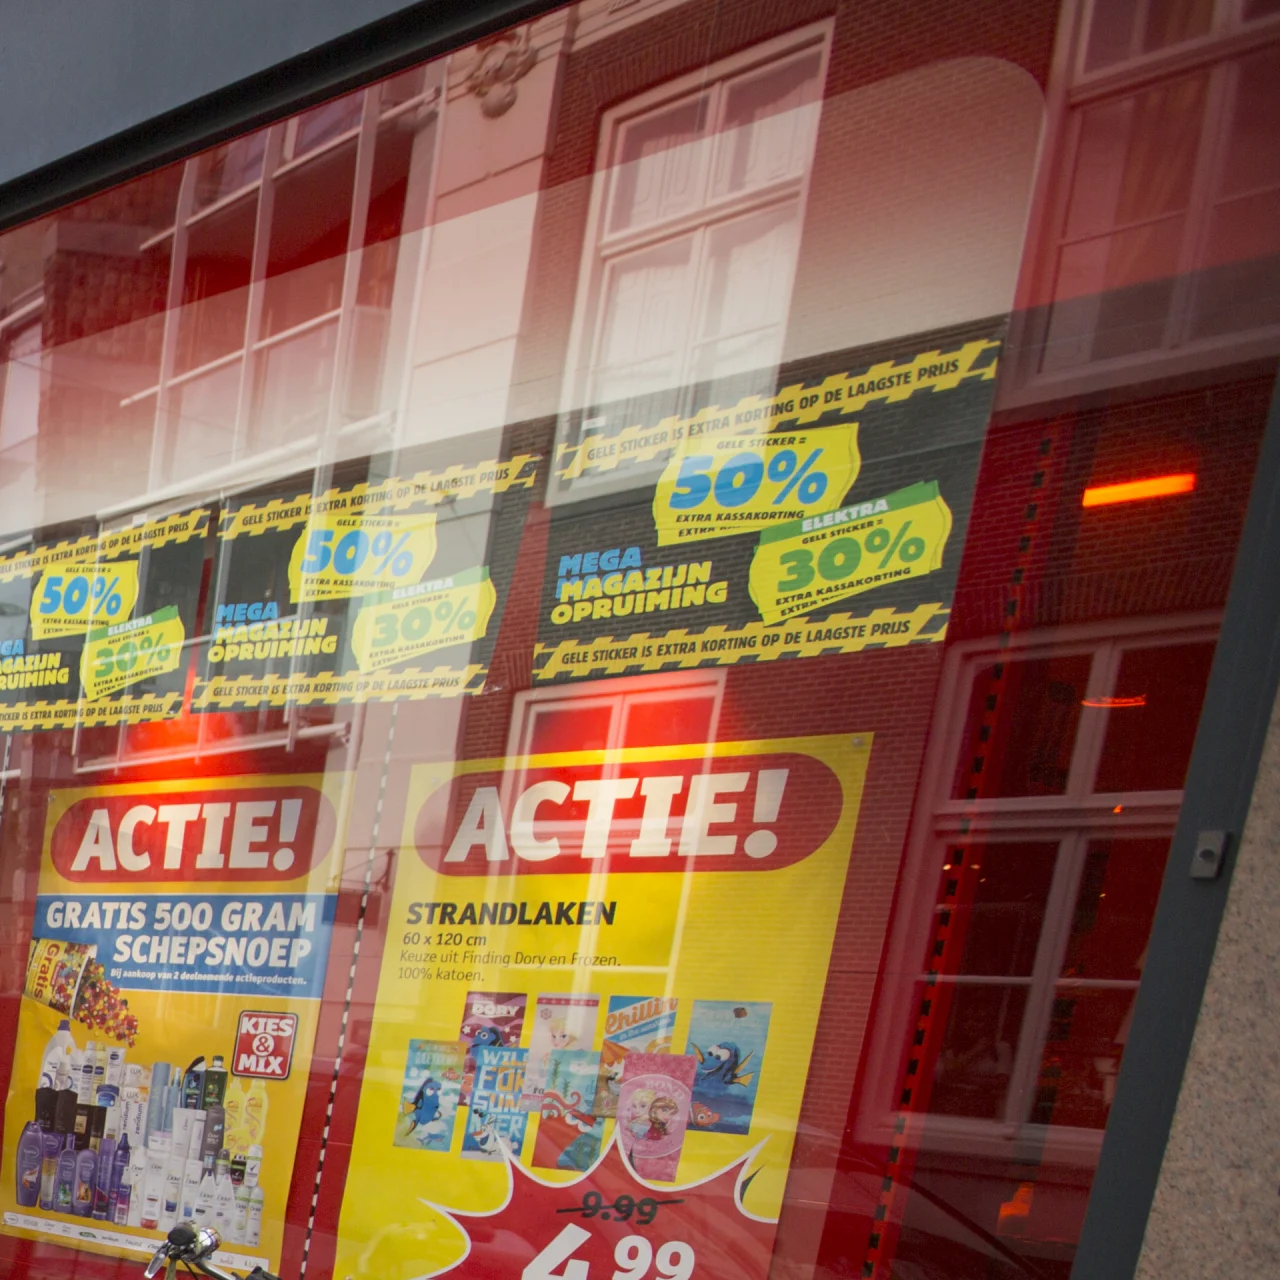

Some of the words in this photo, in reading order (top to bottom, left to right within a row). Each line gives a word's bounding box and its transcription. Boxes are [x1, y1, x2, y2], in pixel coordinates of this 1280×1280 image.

[587, 443, 616, 461] GELE
[620, 428, 667, 455] STICKER
[673, 424, 684, 439] IS
[688, 415, 730, 439] EXTRA
[734, 399, 795, 428] KORTING
[799, 391, 820, 410] OP
[825, 386, 842, 403] DE
[847, 371, 912, 398] LAAGSTE
[917, 359, 960, 380] PRIJS
[717, 440, 744, 449] GELE
[749, 437, 796, 448] STICKER
[669, 448, 828, 510] 50%
[242, 513, 263, 526] GELE
[267, 507, 301, 523] STICKER
[305, 504, 313, 515] IS
[316, 498, 347, 513] EXTRA
[351, 490, 393, 508] KORTING
[396, 487, 410, 499] OP
[413, 482, 427, 496] DE
[430, 474, 475, 493] LAAGSTE
[479, 468, 510, 482] PRIJS
[676, 514, 712, 522] EXTRA
[716, 511, 805, 521] KASSAKORTING
[802, 499, 888, 532] ELEKTRA
[15, 557, 40, 571] STICKER
[42, 556, 48, 564] IS
[51, 550, 73, 562] EXTRA
[76, 542, 106, 556] KORTING
[109, 538, 119, 549] OP
[121, 535, 131, 546] DE
[133, 527, 165, 542] LAAGSTE
[168, 521, 189, 536] PRIJS
[802, 533, 827, 544] GELE
[830, 521, 874, 538] STICKER
[300, 530, 413, 577] 50%
[559, 547, 642, 576] MEGA
[778, 521, 925, 592] 30%
[39, 575, 122, 616] 50%
[305, 578, 330, 586] EXTRA
[393, 578, 454, 599] ELEKTRA
[560, 561, 712, 602] MAGAZIJN
[776, 591, 812, 606] EXTRA
[816, 567, 911, 596] KASSAKORTING
[217, 601, 278, 622] MEGA
[551, 581, 727, 625] OPRUIMING
[108, 616, 152, 636] ELEKTRA
[215, 618, 328, 644] MAGAZIJN
[372, 596, 476, 647] 30%
[95, 632, 170, 678] 30%
[207, 635, 337, 663] OPRUIMING
[561, 651, 589, 664] GELE
[592, 646, 637, 663] STICKER
[642, 645, 653, 657] IS
[657, 640, 697, 656] EXTRA
[701, 635, 758, 652] KORTING
[761, 632, 780, 648] OP
[784, 630, 801, 644] DE
[807, 625, 866, 642] LAAGSTE
[870, 619, 911, 636] PRIJS
[213, 686, 233, 696] GELE
[236, 684, 269, 695] STICKER
[272, 684, 279, 693] IS
[282, 682, 310, 693] EXTRA
[313, 680, 353, 693] KORTING
[356, 681, 370, 691] OP
[372, 680, 384, 690] DE
[387, 678, 430, 690] LAAGSTE
[432, 677, 461, 688] PRIJS
[22, 710, 28, 719] IS
[30, 708, 52, 719] EXTRA
[54, 706, 84, 718] KORTING
[85, 706, 96, 717] OP
[98, 705, 107, 716] DE
[109, 704, 140, 715] LAAGSTE
[143, 703, 163, 713] PRIJS
[444, 769, 789, 862] ACTIE!
[71, 799, 303, 872] ACTIE!
[46, 902, 146, 929] GRATIS
[154, 902, 213, 931] 500
[221, 903, 316, 932] GRAM
[406, 902, 617, 925] STRANDLAKEN
[113, 935, 312, 967] SCHEPSNOEP
[403, 932, 420, 945] 60
[424, 936, 431, 945] x
[435, 933, 462, 946] 120
[466, 936, 487, 946] cm
[34, 943, 60, 999] Gratis
[398, 967, 432, 980] 100%
[436, 968, 485, 981] katoen.
[400, 951, 437, 963] Keuze
[441, 952, 458, 963] uit
[462, 952, 510, 968] Finding
[514, 953, 545, 969] Dory
[550, 955, 565, 965] en
[571, 953, 621, 967] Frozen.
[110, 968, 122, 979] Bij
[123, 969, 155, 981] aankoop
[174, 971, 179, 980] 2
[180, 972, 233, 982] deelnemende
[235, 974, 307, 985] actieproducten.
[472, 1001, 520, 1017] DORY
[241, 1016, 293, 1037] KIES
[253, 1032, 274, 1056] &
[239, 1055, 284, 1076] MIX
[581, 1190, 658, 1224] 9.99
